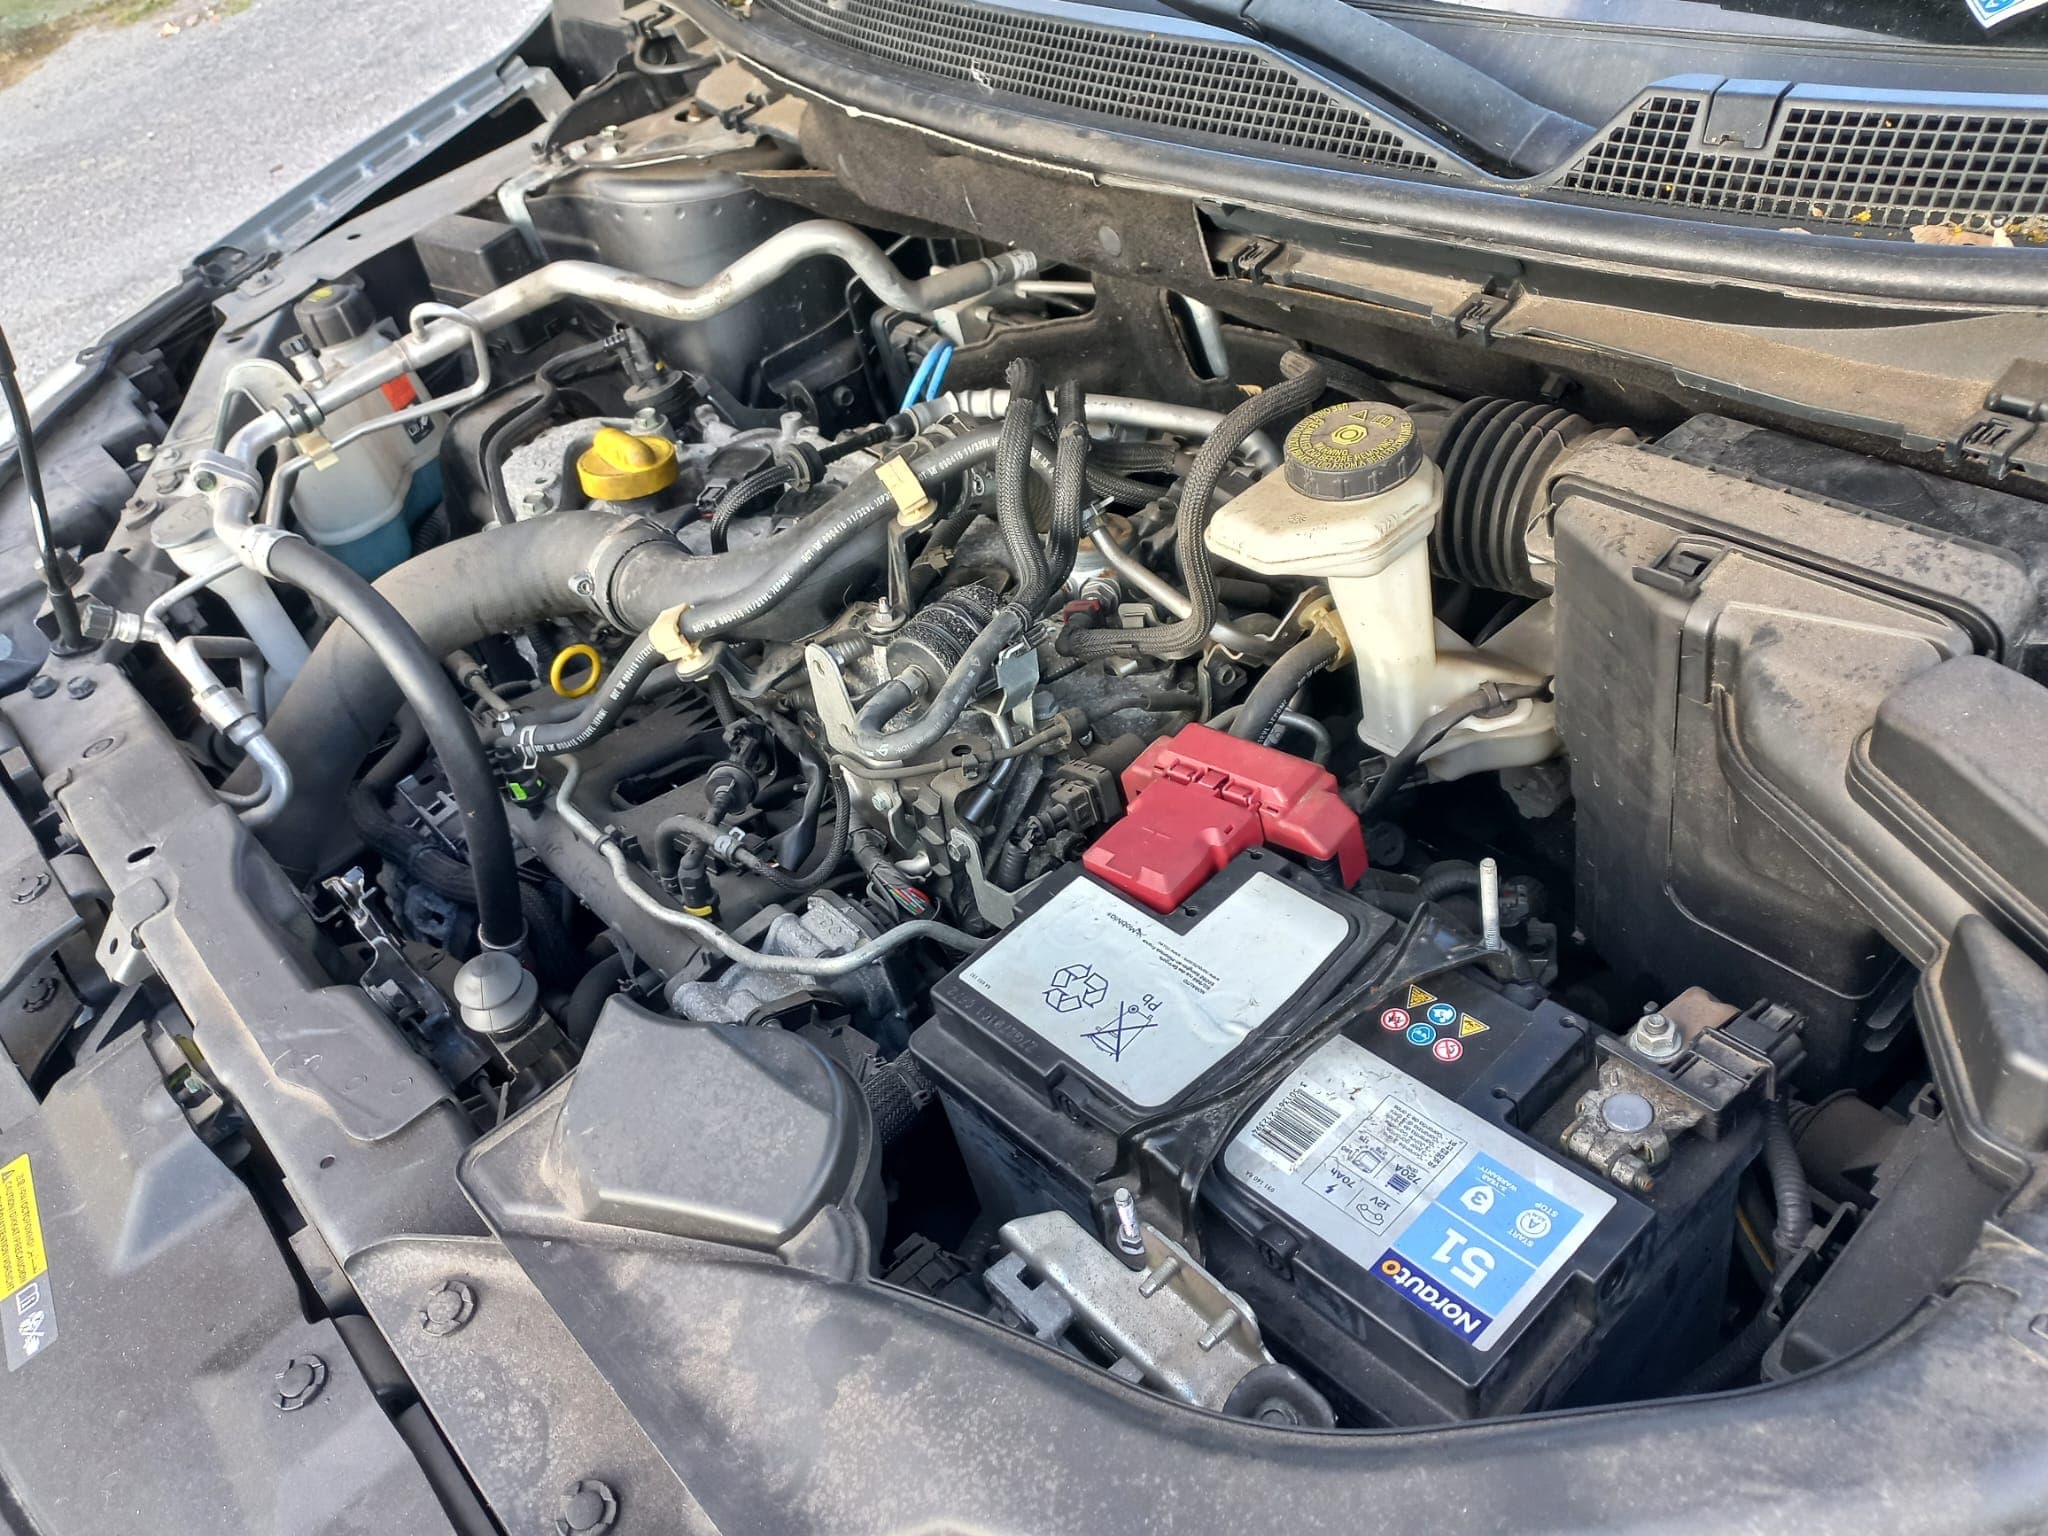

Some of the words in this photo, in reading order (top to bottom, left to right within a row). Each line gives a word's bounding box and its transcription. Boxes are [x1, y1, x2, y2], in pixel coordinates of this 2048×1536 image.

[1142, 994, 1163, 1012] Pb
[1330, 1168, 1356, 1188] 70Ah
[1395, 1164, 1421, 1185] 720A
[1482, 1174, 1507, 1191] 3-YEAR
[1369, 1196, 1390, 1211] 12V
[1471, 1191, 1488, 1206] 3
[1535, 1202, 1558, 1217] STOP
[1528, 1218, 1540, 1229] A
[1512, 1230, 1534, 1247] START
[1432, 1228, 1495, 1288] 51
[1382, 1260, 1481, 1333] Norauto
